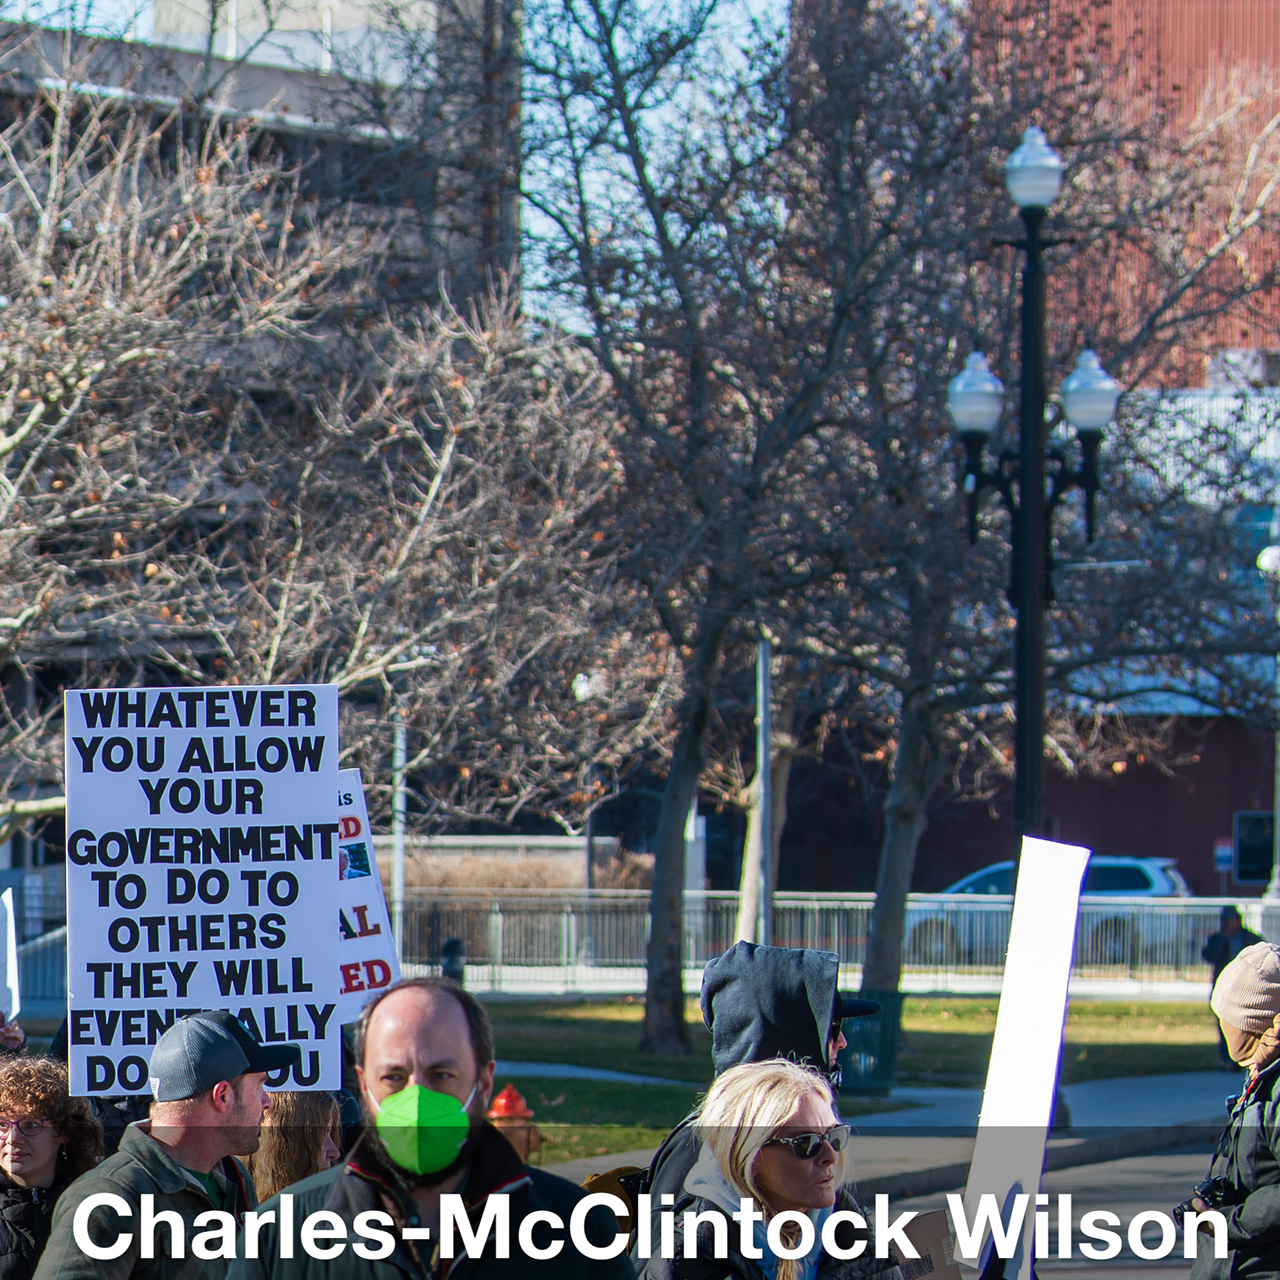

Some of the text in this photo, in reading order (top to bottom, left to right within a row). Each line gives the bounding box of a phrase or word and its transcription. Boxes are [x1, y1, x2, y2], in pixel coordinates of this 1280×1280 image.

[79, 690, 317, 728] WHATEVER
[72, 735, 326, 774] YOU ALLOW
[138, 778, 264, 815] YOUR
[67, 823, 339, 867] GOVERNMENT
[90, 868, 299, 910] TO DO TO
[107, 913, 287, 953] OTHERS
[86, 961, 198, 999] THEY
[213, 956, 313, 997] WILL
[70, 1003, 337, 1047] EVENALLY
[86, 1054, 149, 1092] DO
